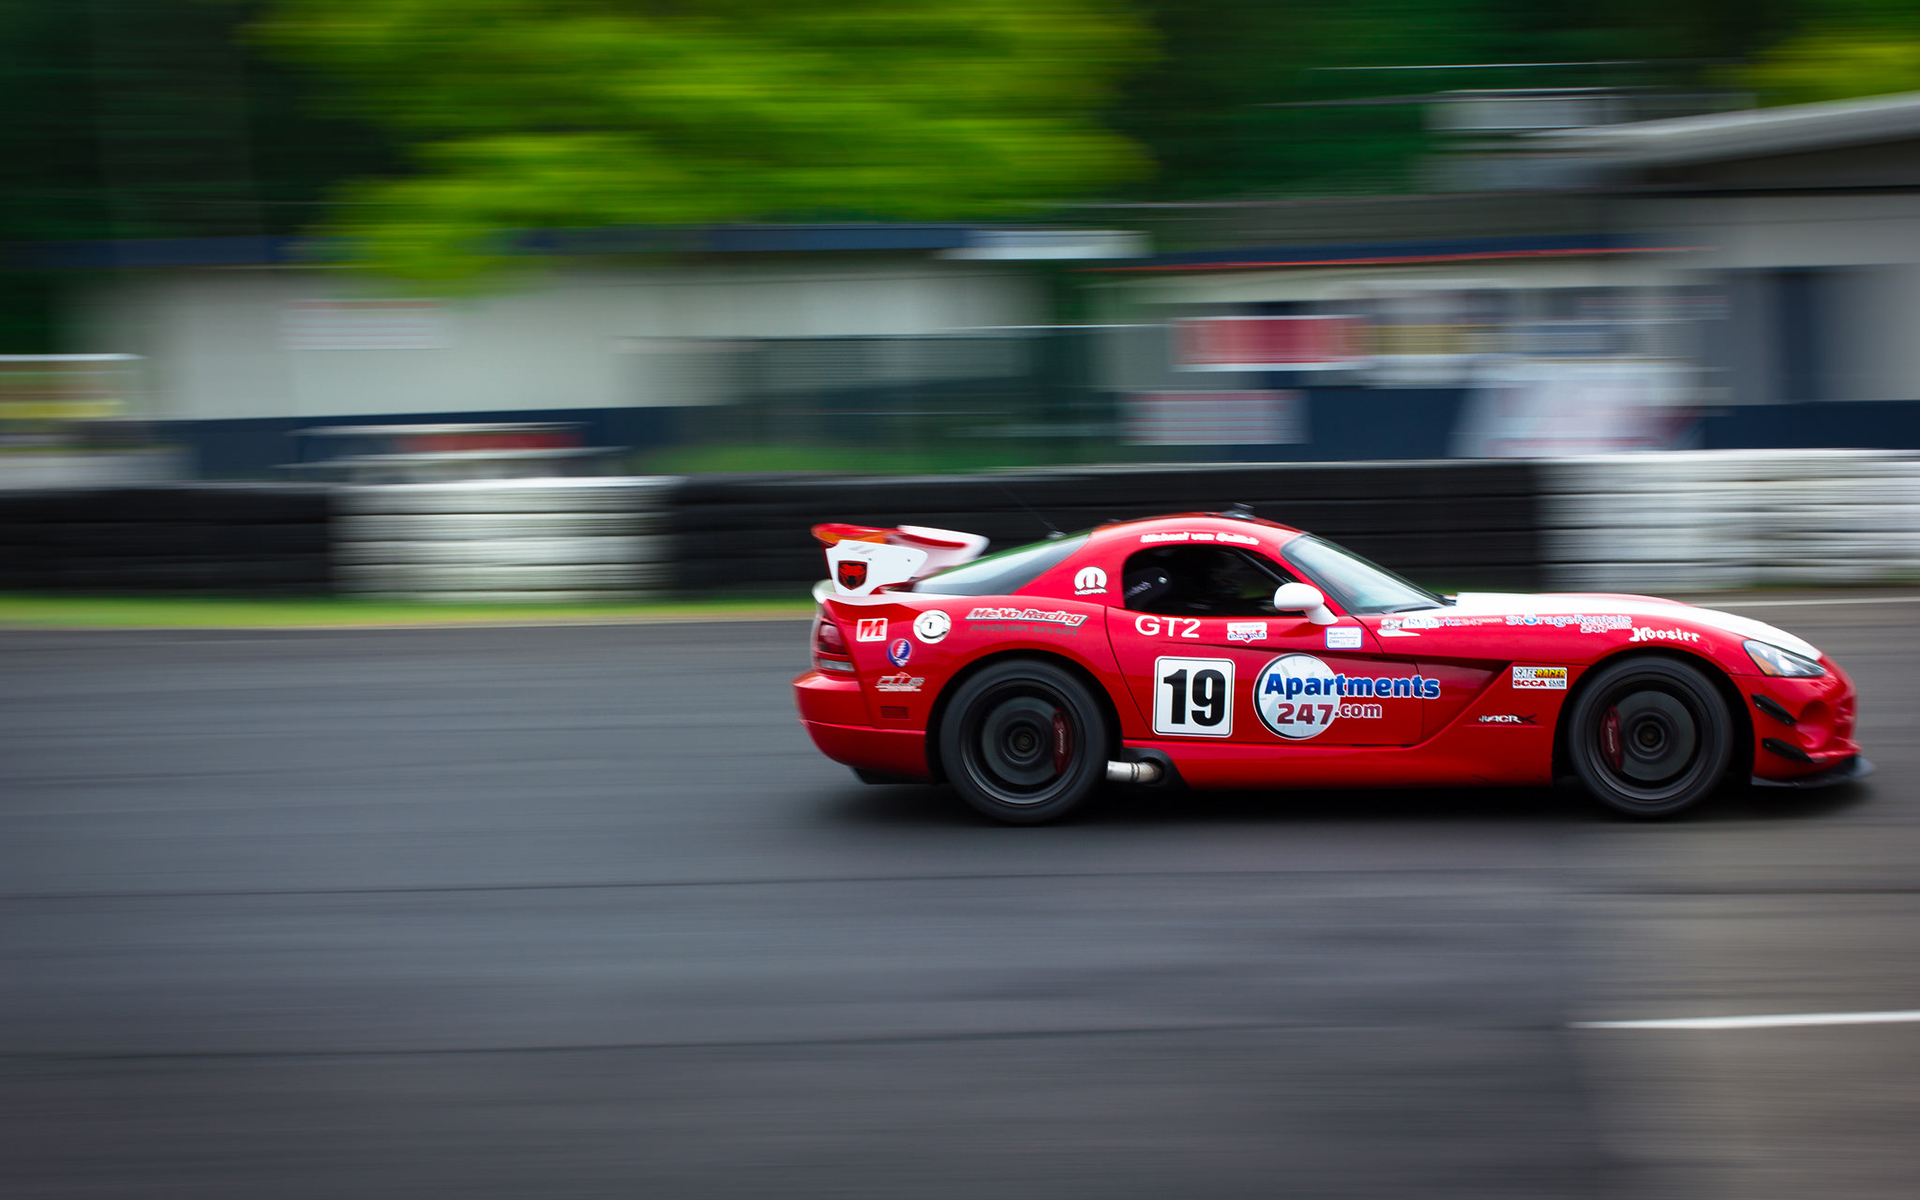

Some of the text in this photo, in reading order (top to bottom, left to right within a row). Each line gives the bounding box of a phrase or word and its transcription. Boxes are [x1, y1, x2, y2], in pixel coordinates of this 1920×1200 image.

[1021, 609, 1085, 625] Racing
[1135, 614, 1201, 638] GT2
[1629, 627, 1701, 643] Hoosier
[1264, 673, 1441, 700] Apartments
[1514, 679, 1547, 687] SCCA
[1163, 668, 1226, 727] 19
[1277, 702, 1383, 726] 247.com
